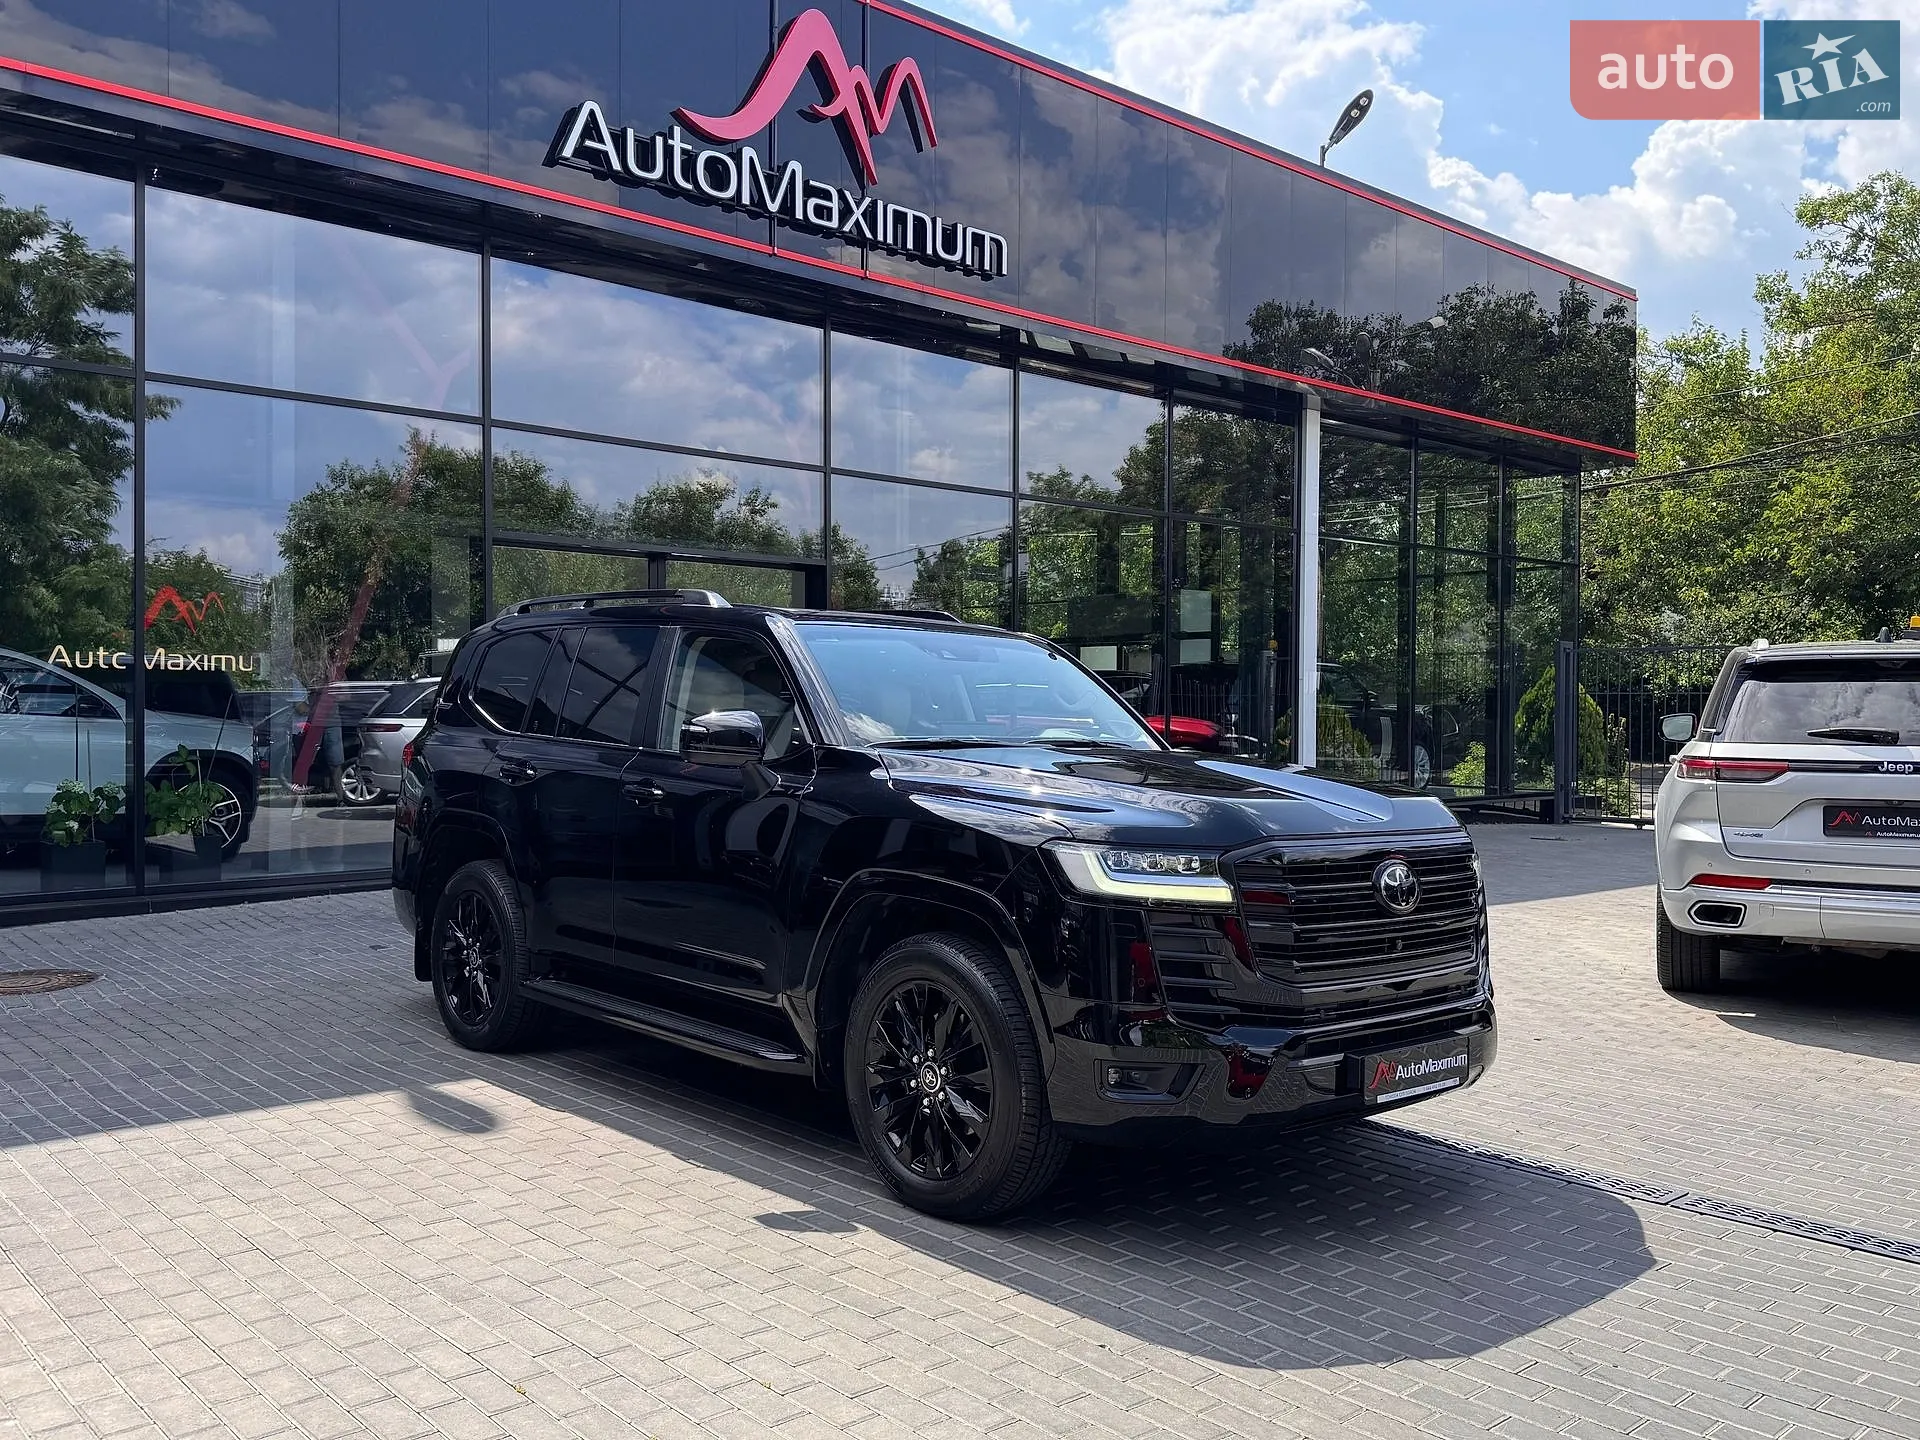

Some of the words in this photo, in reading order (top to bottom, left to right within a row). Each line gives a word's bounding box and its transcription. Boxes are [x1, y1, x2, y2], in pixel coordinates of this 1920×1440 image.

[558, 99, 1009, 278] AutoMaximum
[1877, 760, 1914, 775] Jeep
[1861, 814, 1920, 827] AutoMa
[1395, 1053, 1468, 1081] AutoMaximum
